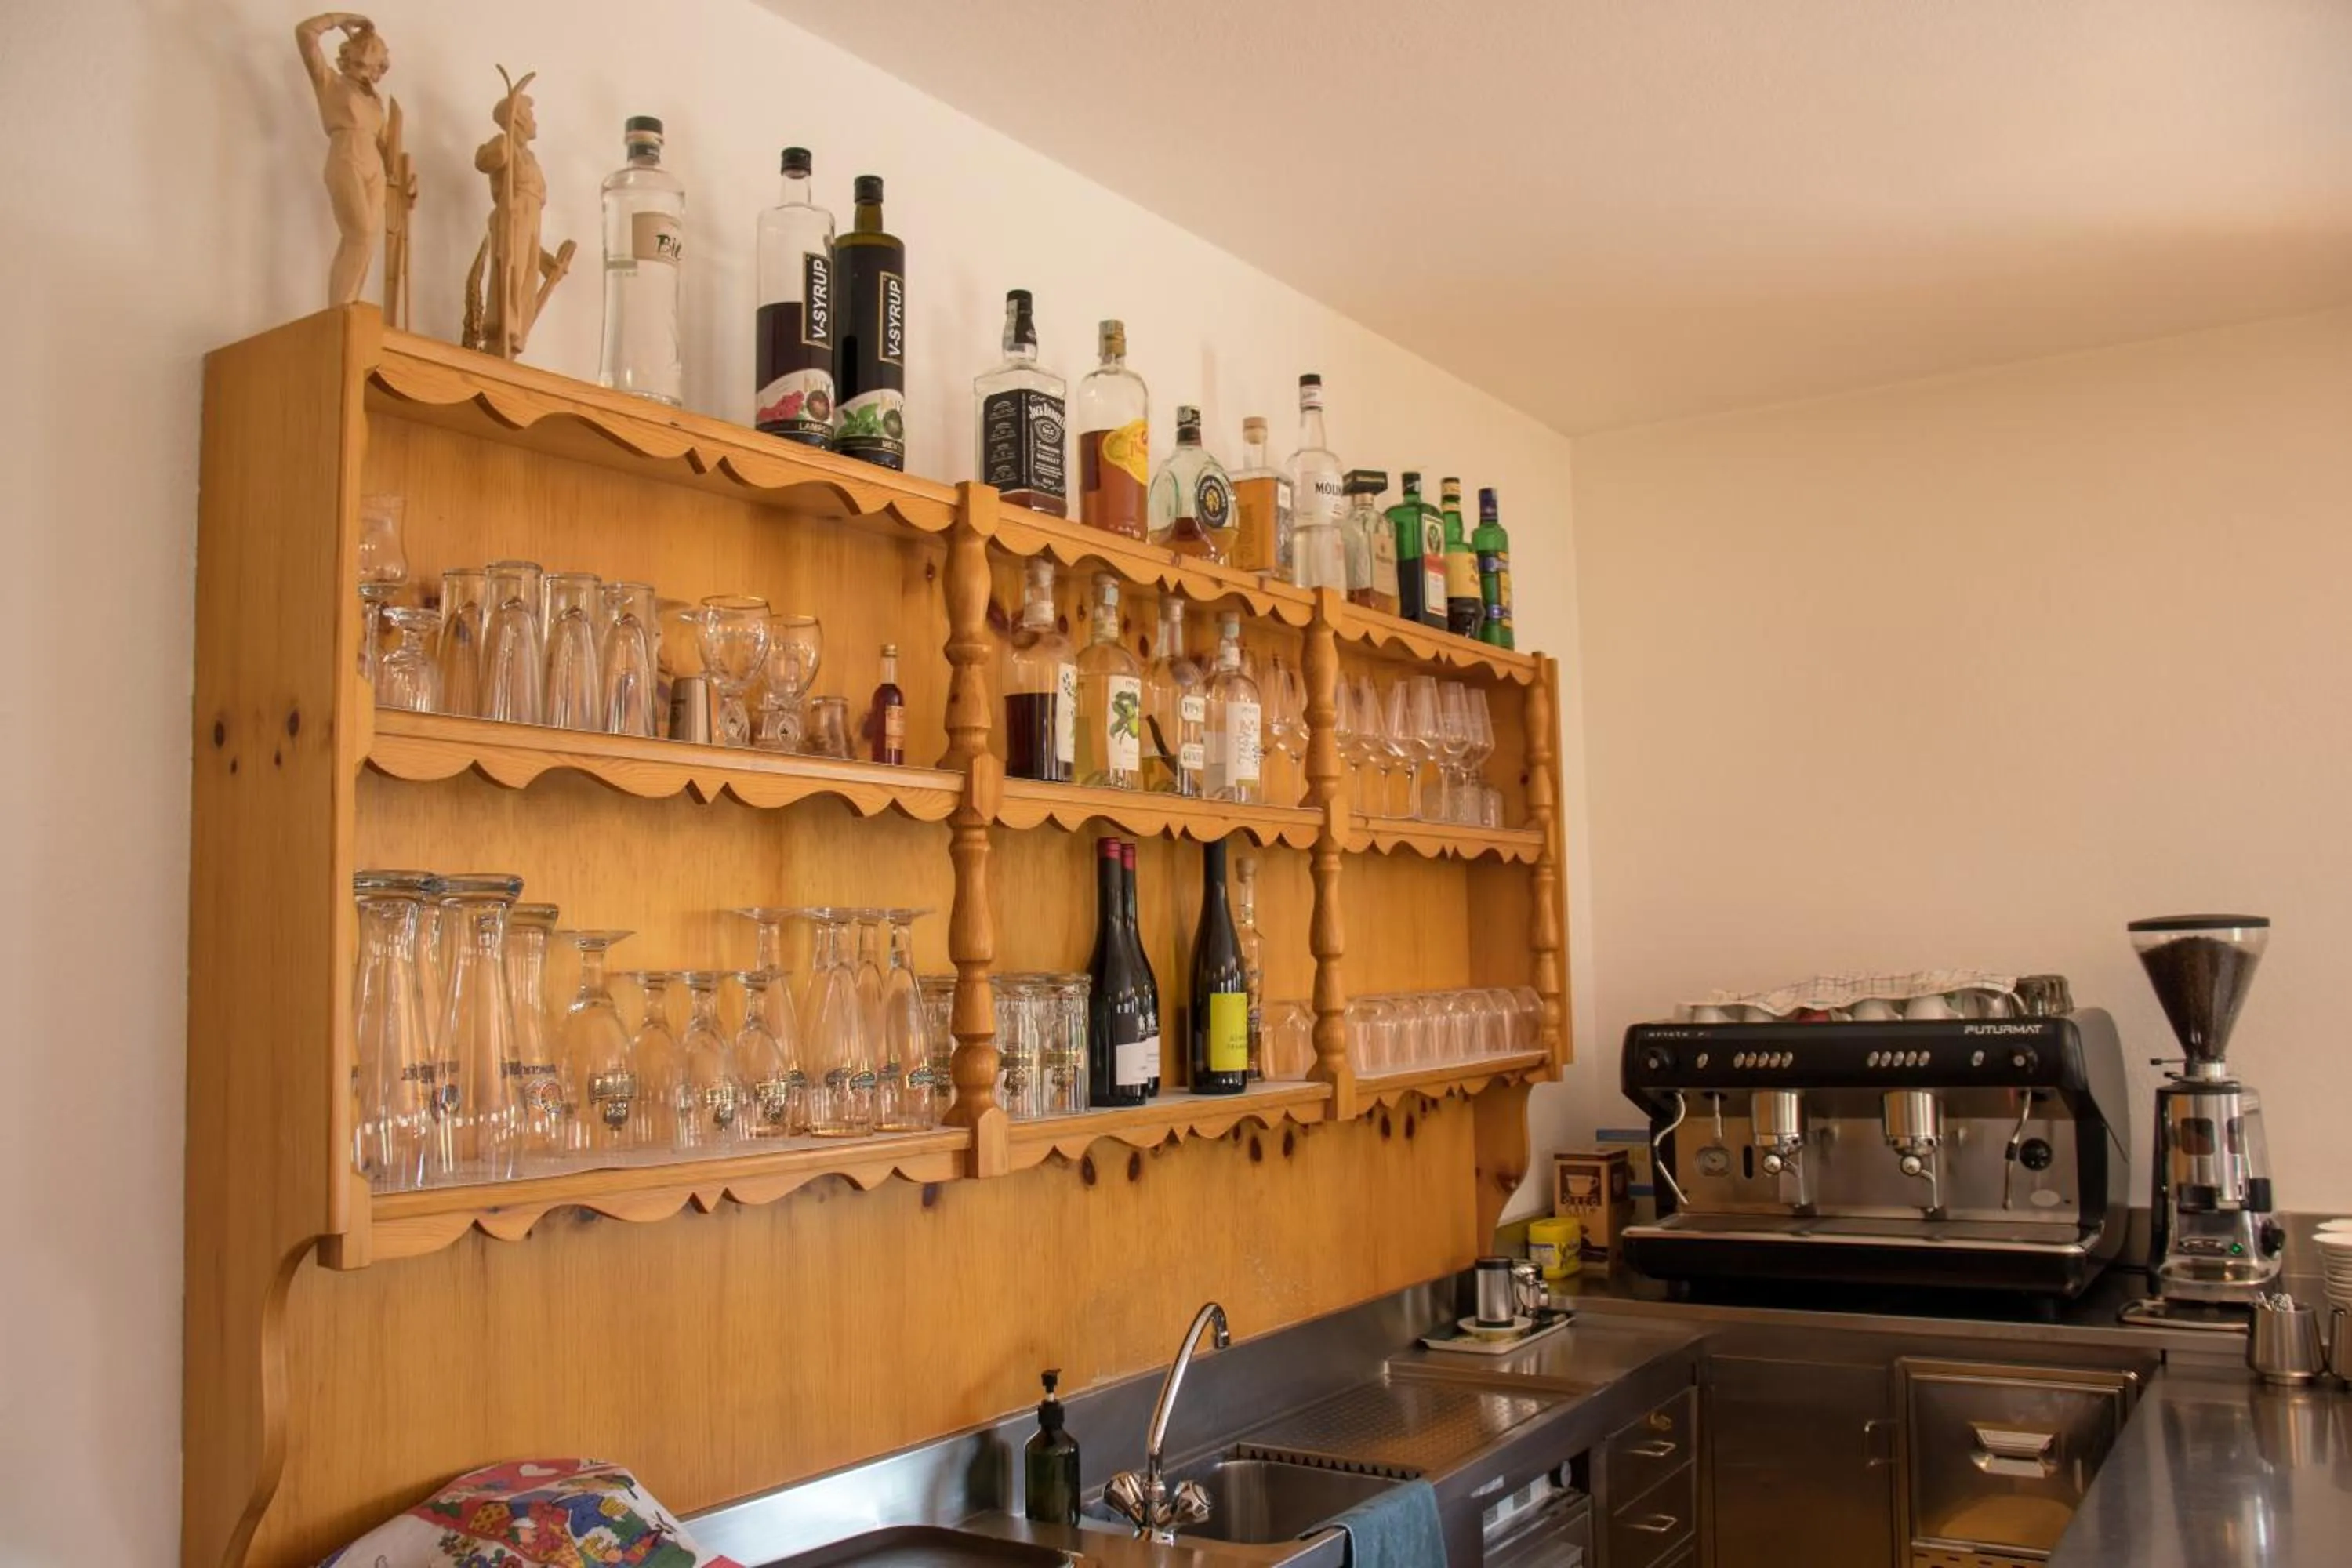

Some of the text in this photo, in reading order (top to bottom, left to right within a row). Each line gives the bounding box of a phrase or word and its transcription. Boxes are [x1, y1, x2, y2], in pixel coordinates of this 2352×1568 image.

[813, 260, 829, 339] V-SYRUP
[888, 280, 903, 357] V-SYRUP
[1964, 1024, 2043, 1035] FUTURMAT
